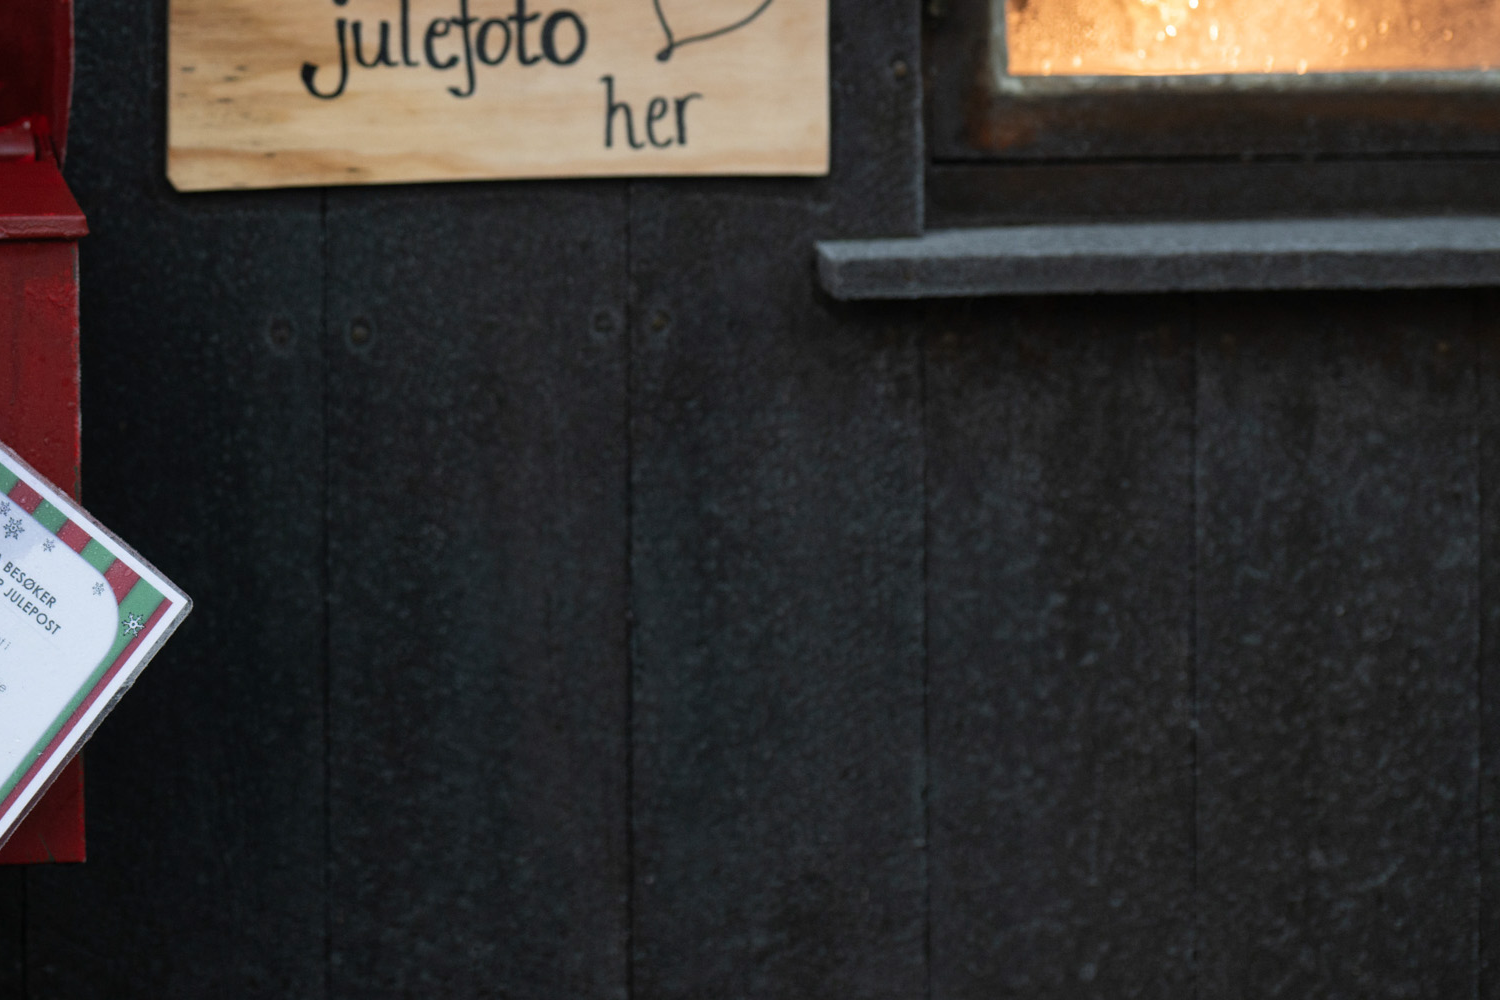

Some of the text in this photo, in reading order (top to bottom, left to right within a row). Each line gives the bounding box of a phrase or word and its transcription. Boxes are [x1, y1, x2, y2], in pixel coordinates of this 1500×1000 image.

[599, 75, 702, 149] her
[2, 560, 56, 608] BESØKER
[2, 587, 61, 634] JULEPOST
